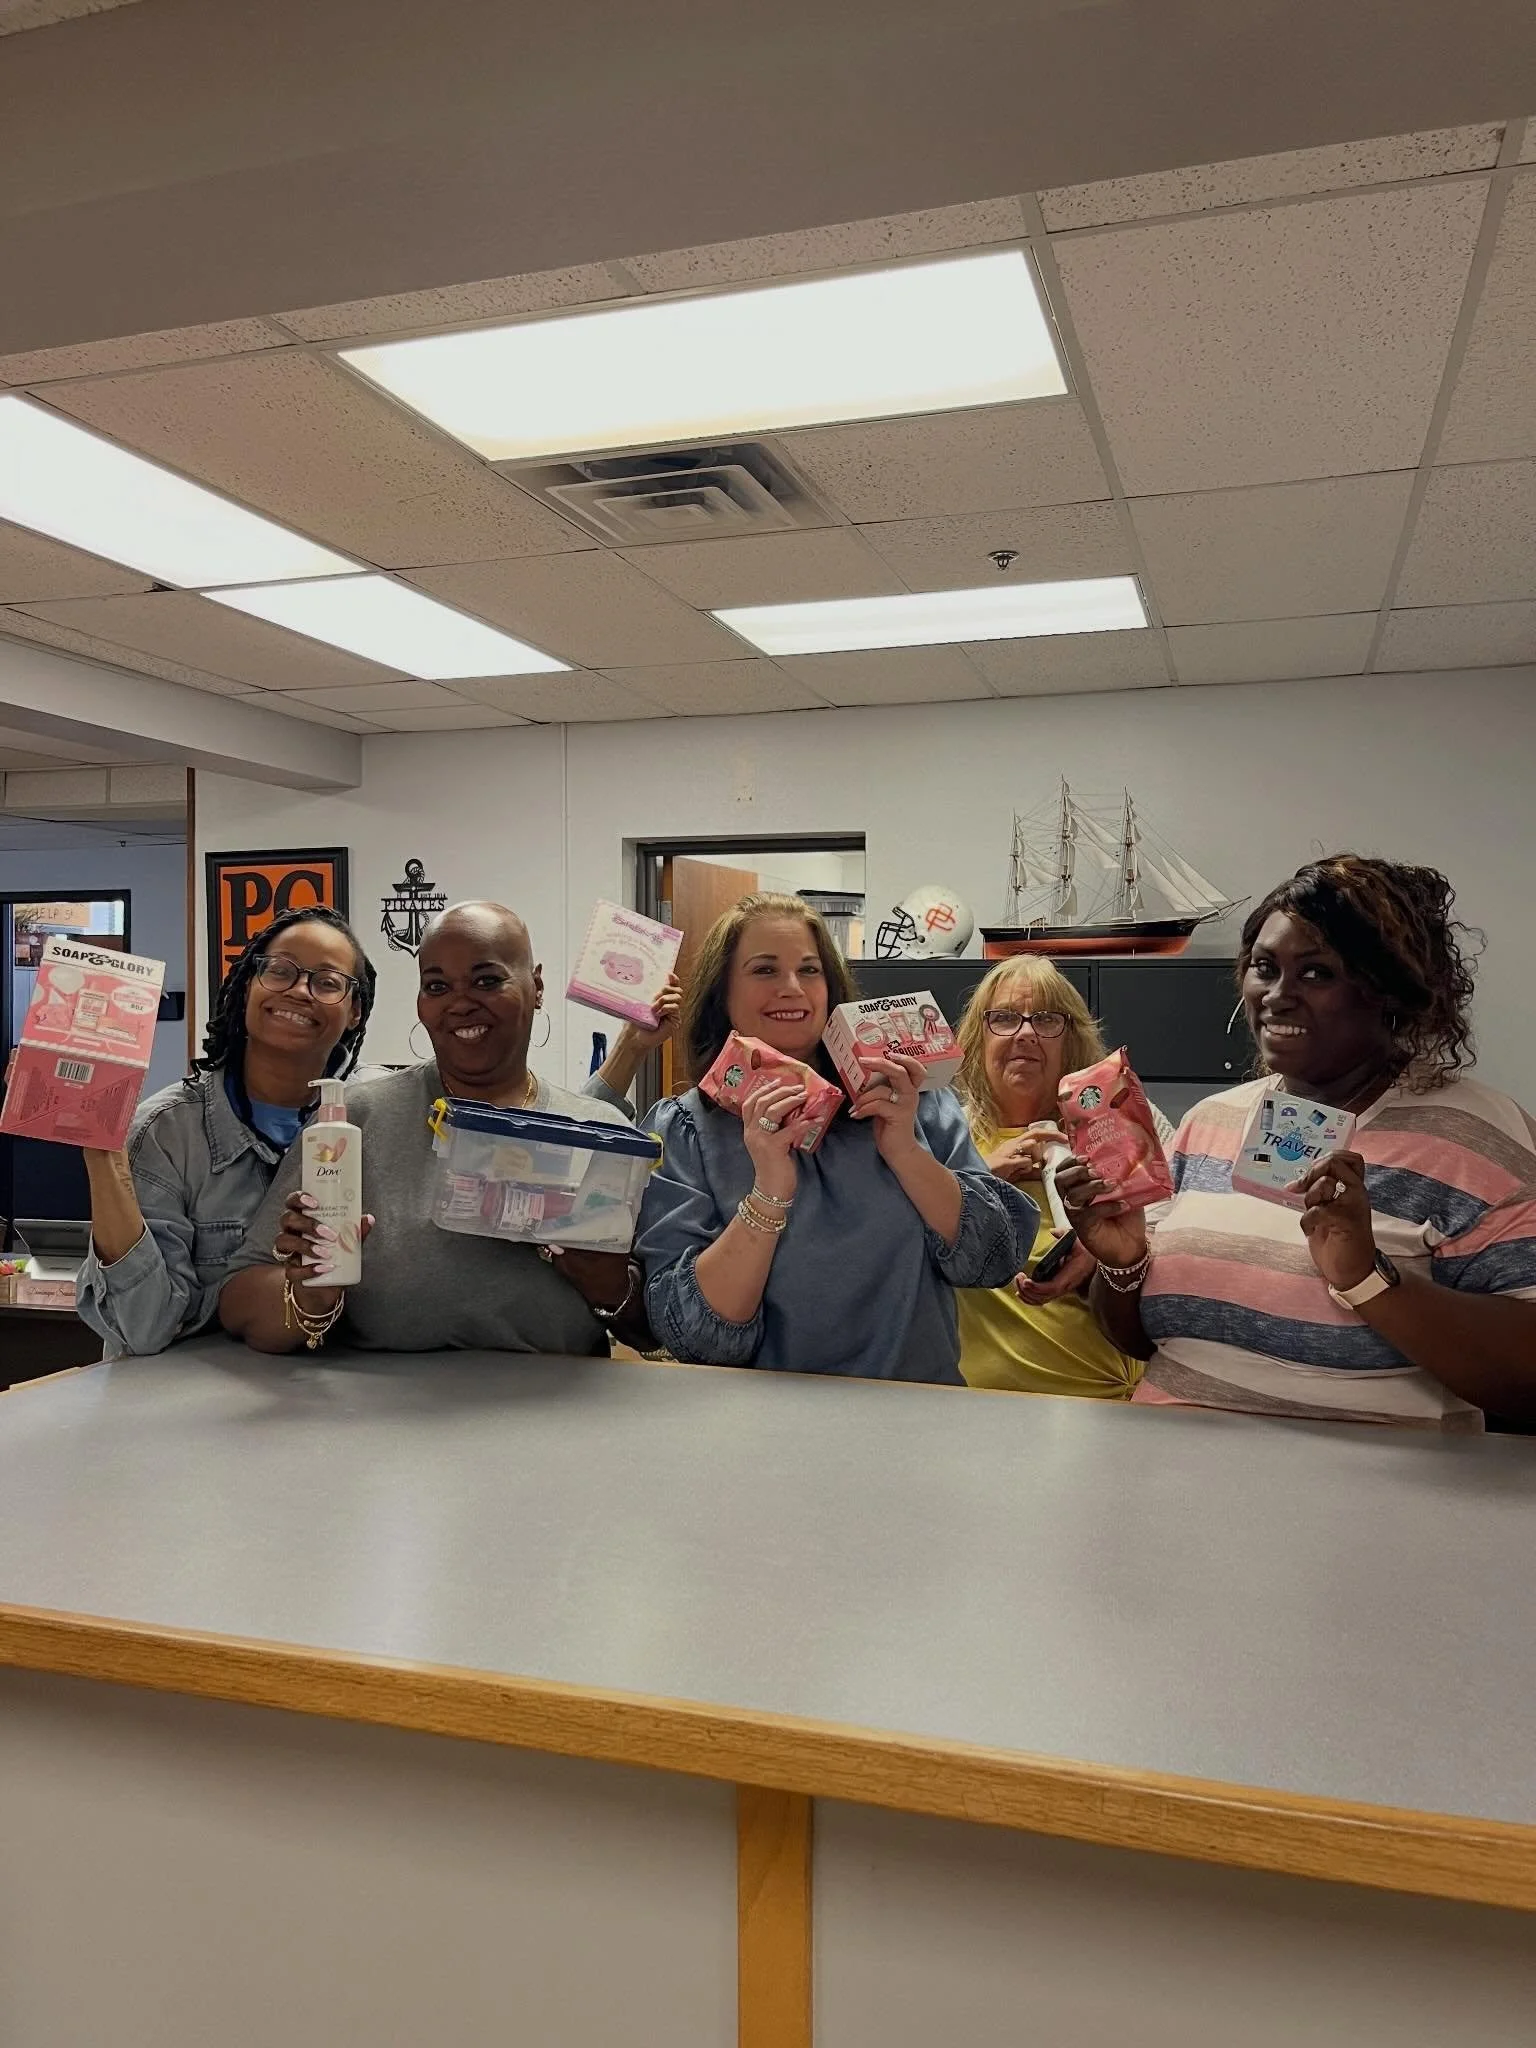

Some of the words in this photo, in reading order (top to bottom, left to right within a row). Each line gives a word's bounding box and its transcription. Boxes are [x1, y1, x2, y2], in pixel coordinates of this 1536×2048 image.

[384, 900, 445, 910] PIRATES
[52, 946, 88, 961] SOAP
[111, 961, 154, 977] GLORY
[858, 1001, 881, 1014] SOAP
[892, 996, 918, 1010] GLORY
[316, 1166, 342, 1177] Dove
